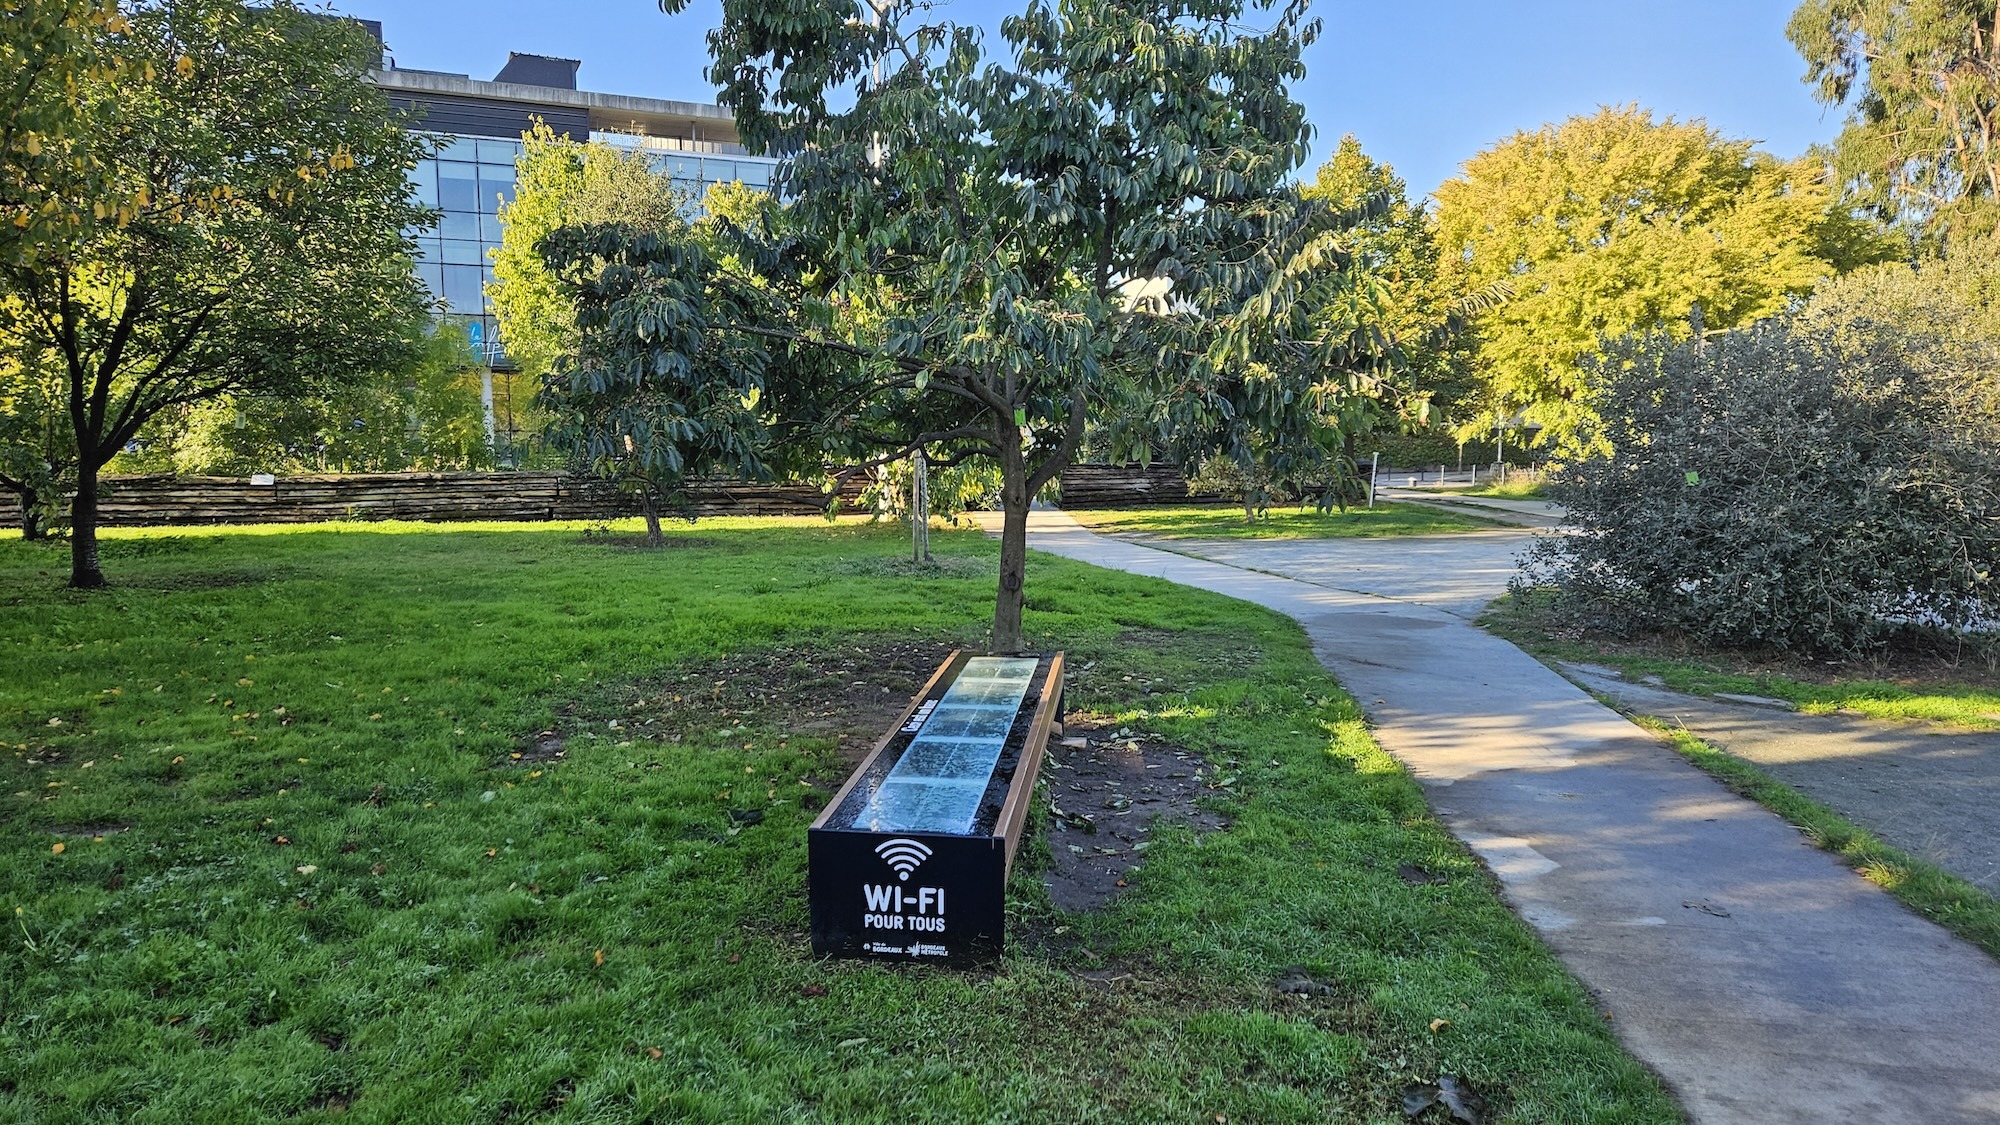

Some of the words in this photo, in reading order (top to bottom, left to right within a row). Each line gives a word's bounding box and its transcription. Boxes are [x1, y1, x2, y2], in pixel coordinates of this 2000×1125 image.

[863, 884, 944, 915] WI-FI
[864, 914, 904, 930] POUR
[907, 916, 945, 932] TOUS
[872, 946, 902, 954] BORDEAUX
